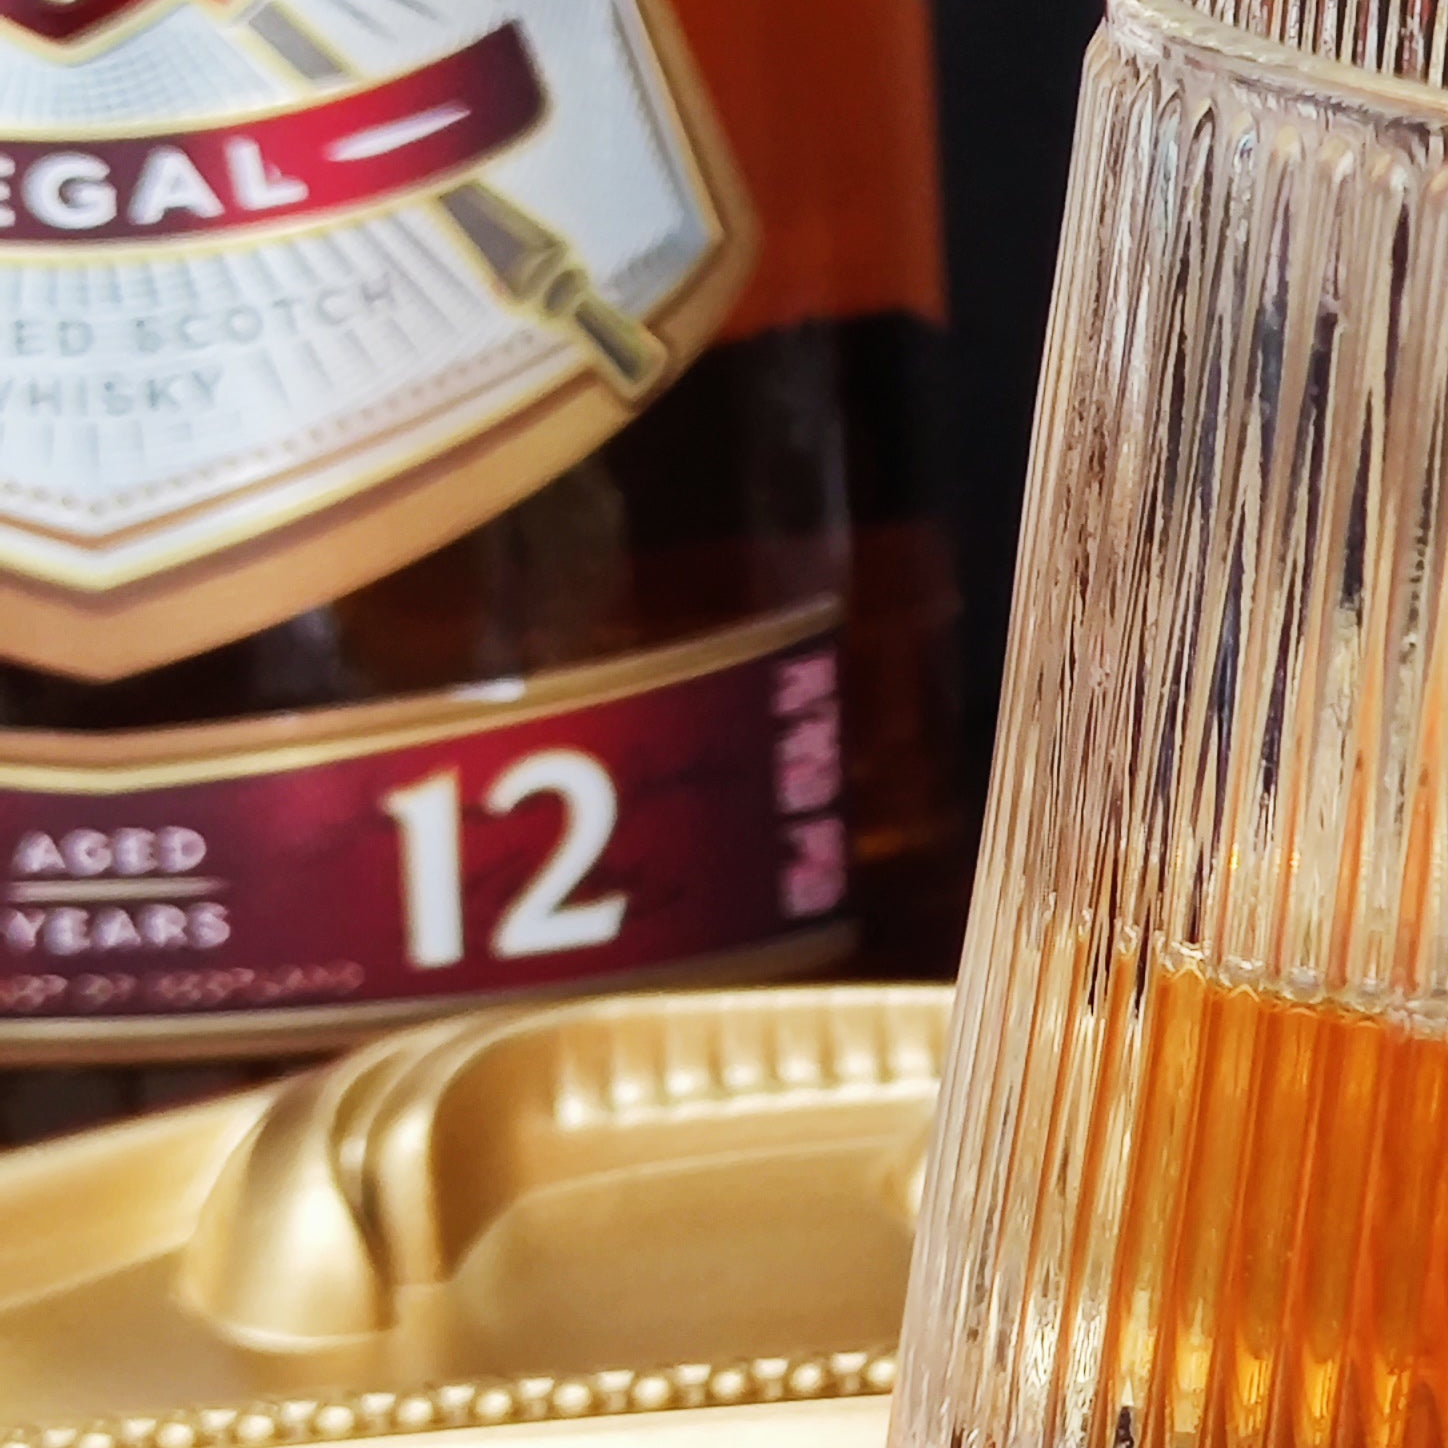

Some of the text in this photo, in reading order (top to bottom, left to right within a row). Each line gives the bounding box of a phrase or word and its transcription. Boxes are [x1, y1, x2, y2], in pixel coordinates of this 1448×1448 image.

[0, 135, 309, 230] GAL
[134, 272, 397, 354] SCOTCH
[0, 365, 224, 418] HISKY
[12, 825, 207, 877] AGED
[380, 747, 628, 968] 12
[0, 902, 231, 955] YEARS
